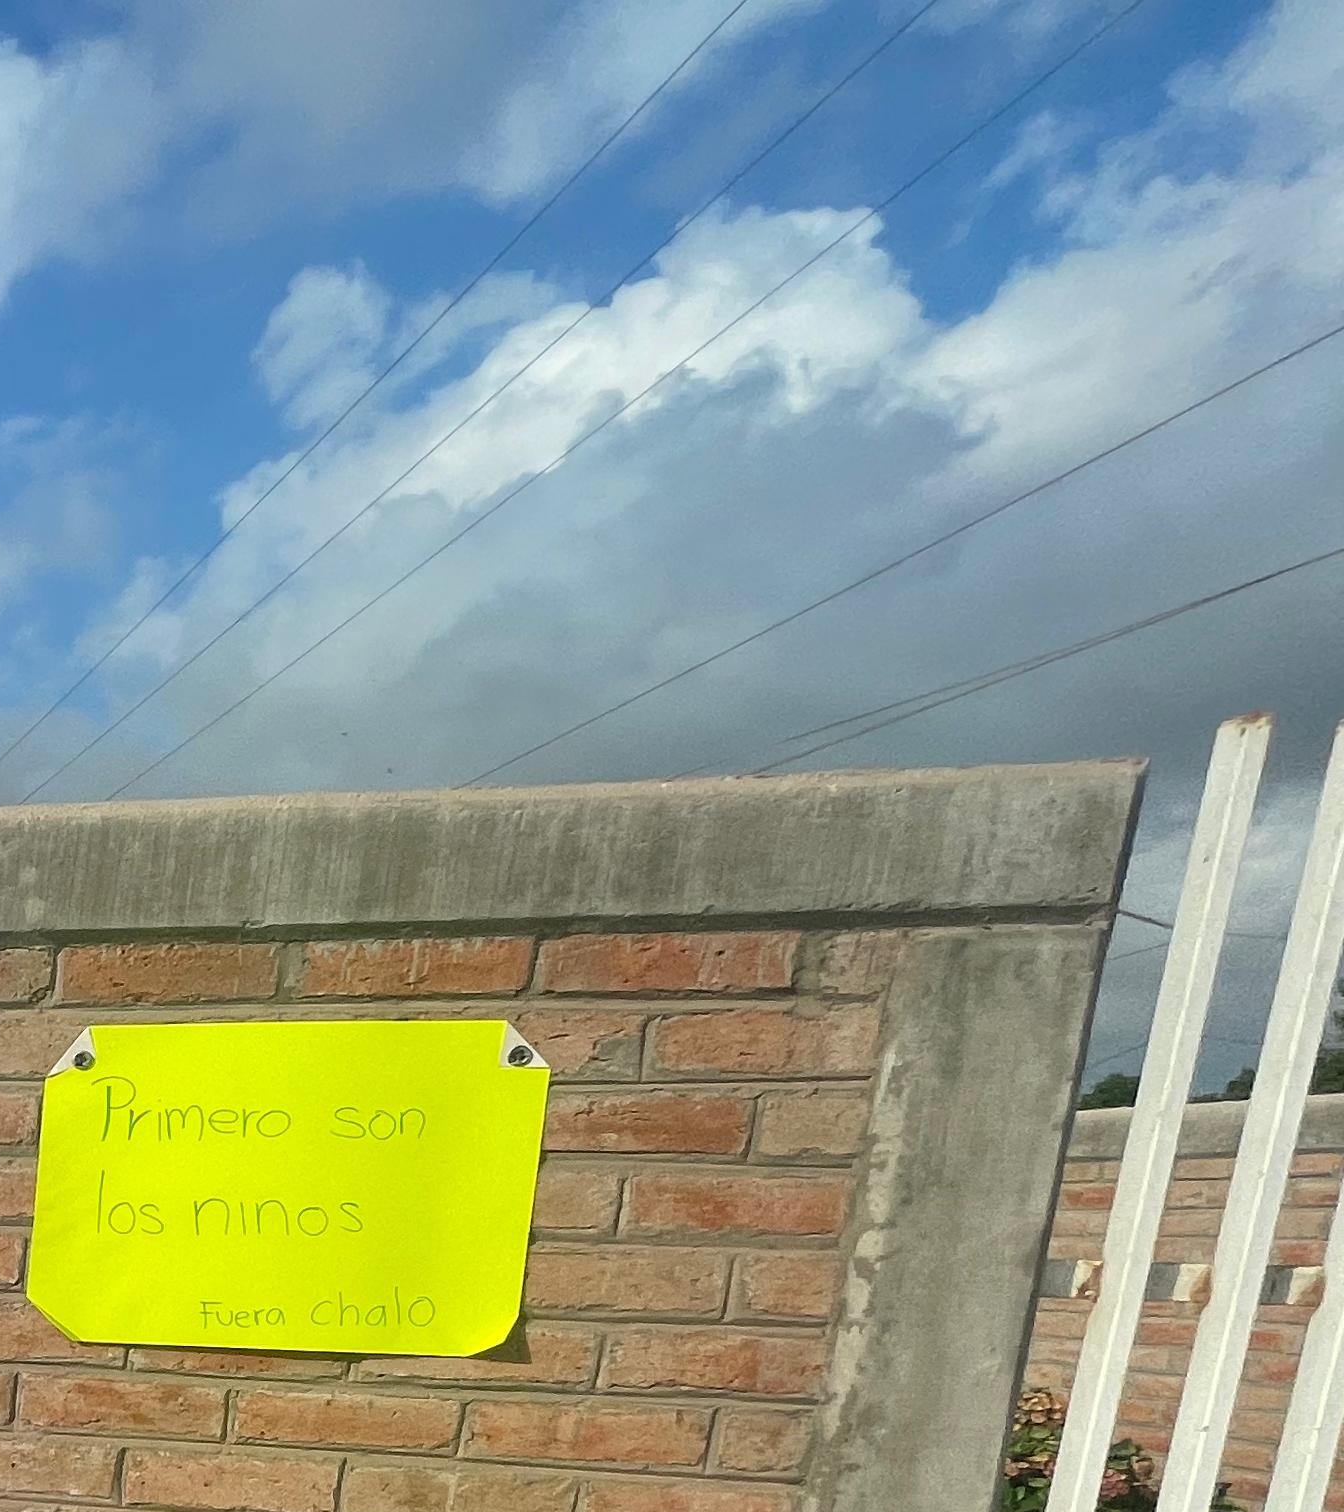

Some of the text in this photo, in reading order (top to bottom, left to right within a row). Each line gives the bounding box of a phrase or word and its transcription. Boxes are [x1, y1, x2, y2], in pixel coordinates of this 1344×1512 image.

[91, 1075, 426, 1142] Primero son
[97, 1169, 164, 1235] los
[199, 1300, 286, 1329] Fuera
